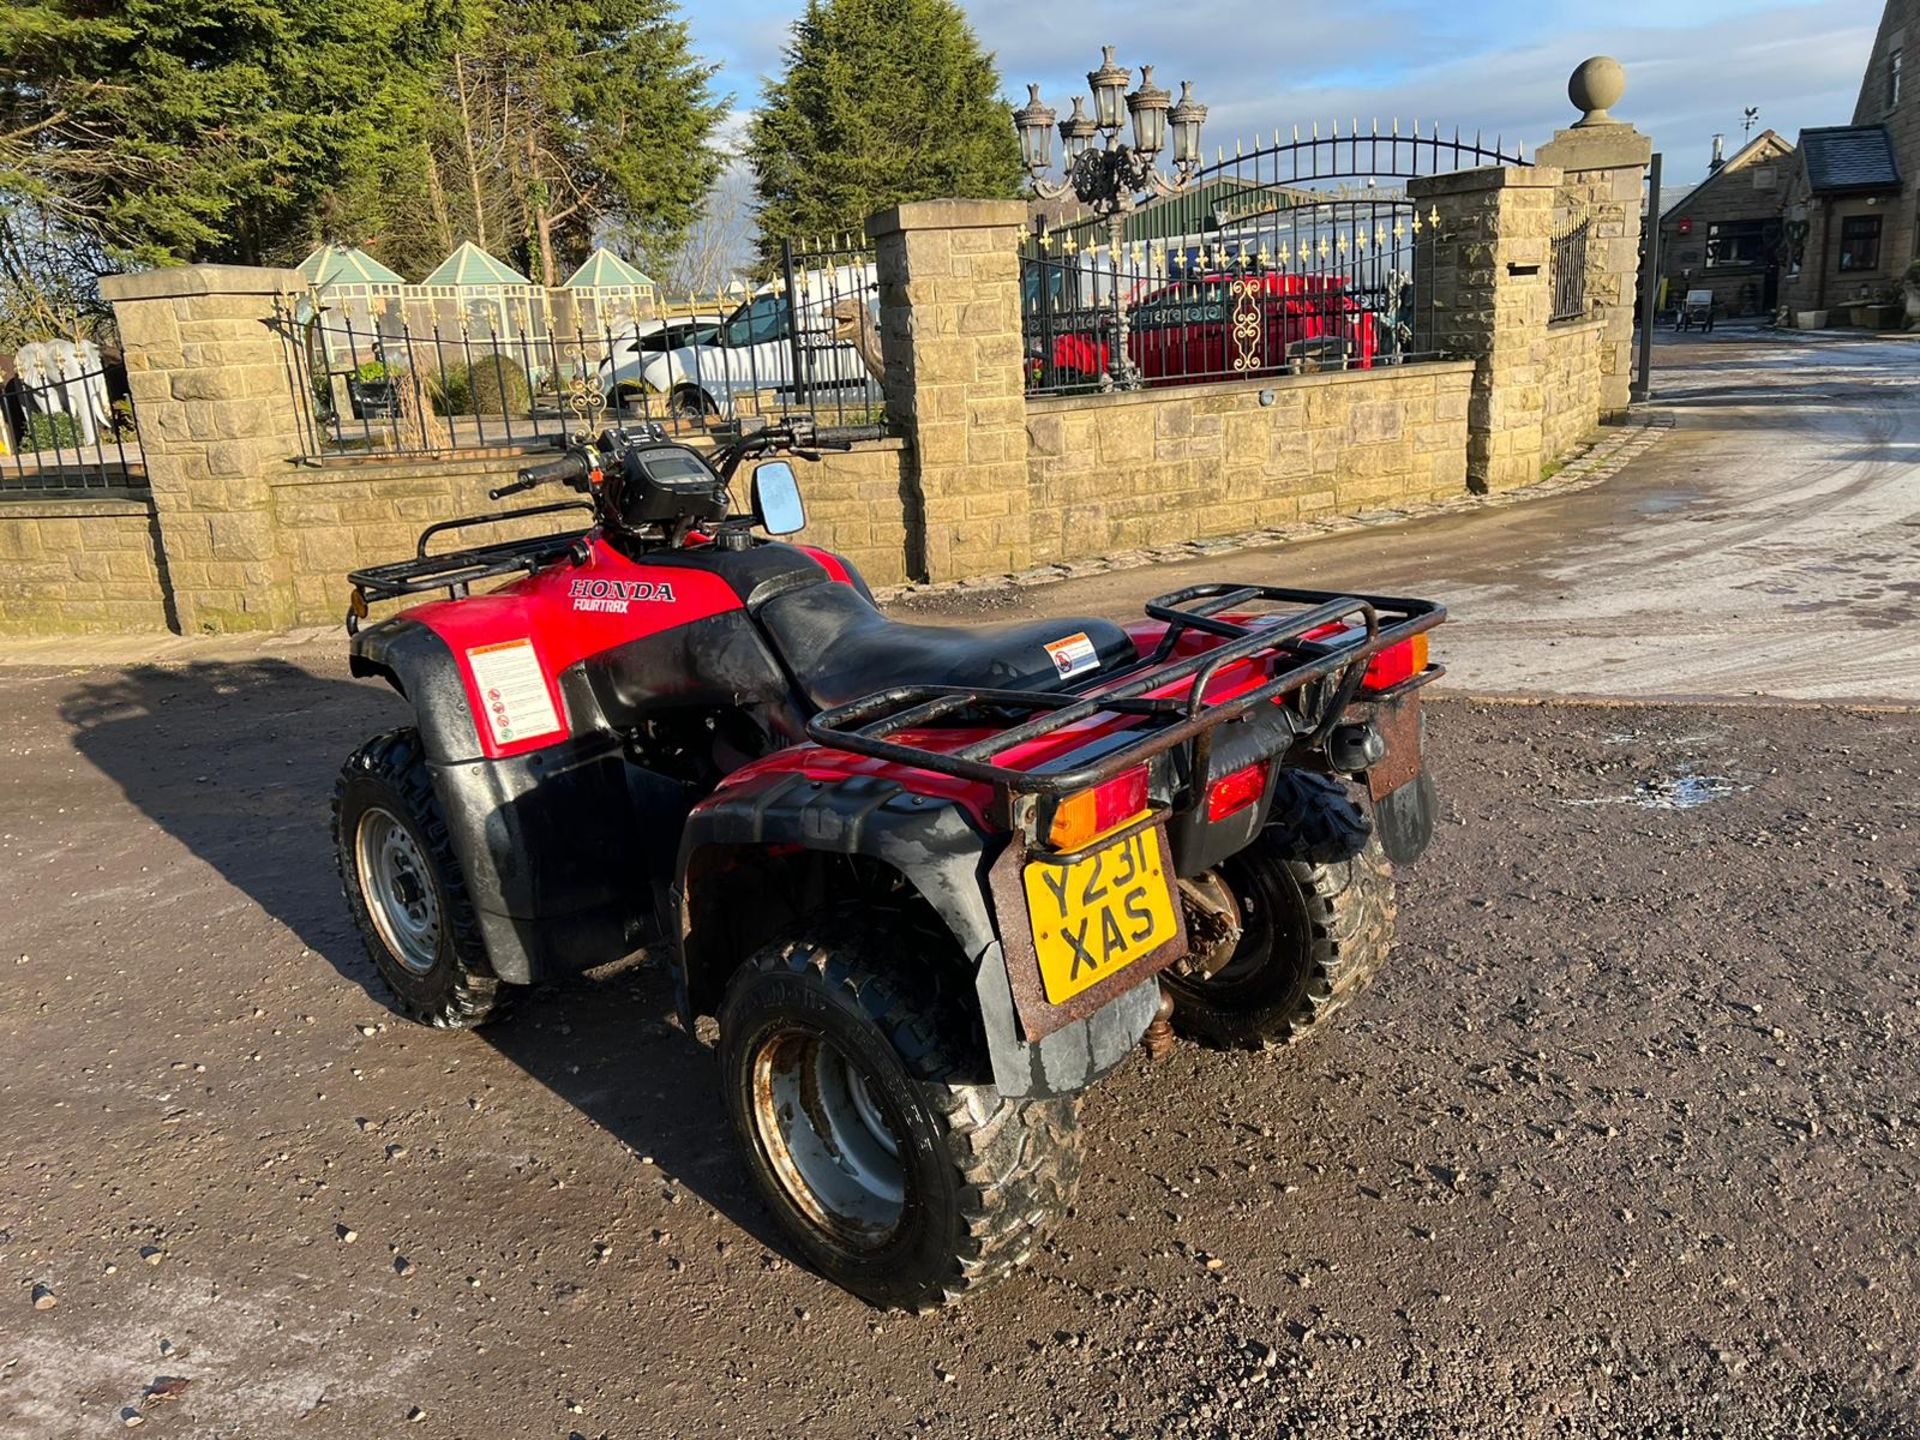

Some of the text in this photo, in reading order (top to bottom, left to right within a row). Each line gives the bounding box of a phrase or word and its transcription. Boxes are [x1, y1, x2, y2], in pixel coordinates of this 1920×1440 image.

[568, 579, 676, 603] HONDA
[573, 598, 629, 614] FOURTRAX
[1042, 834, 1148, 919] Y231
[1060, 886, 1155, 982] XAS
